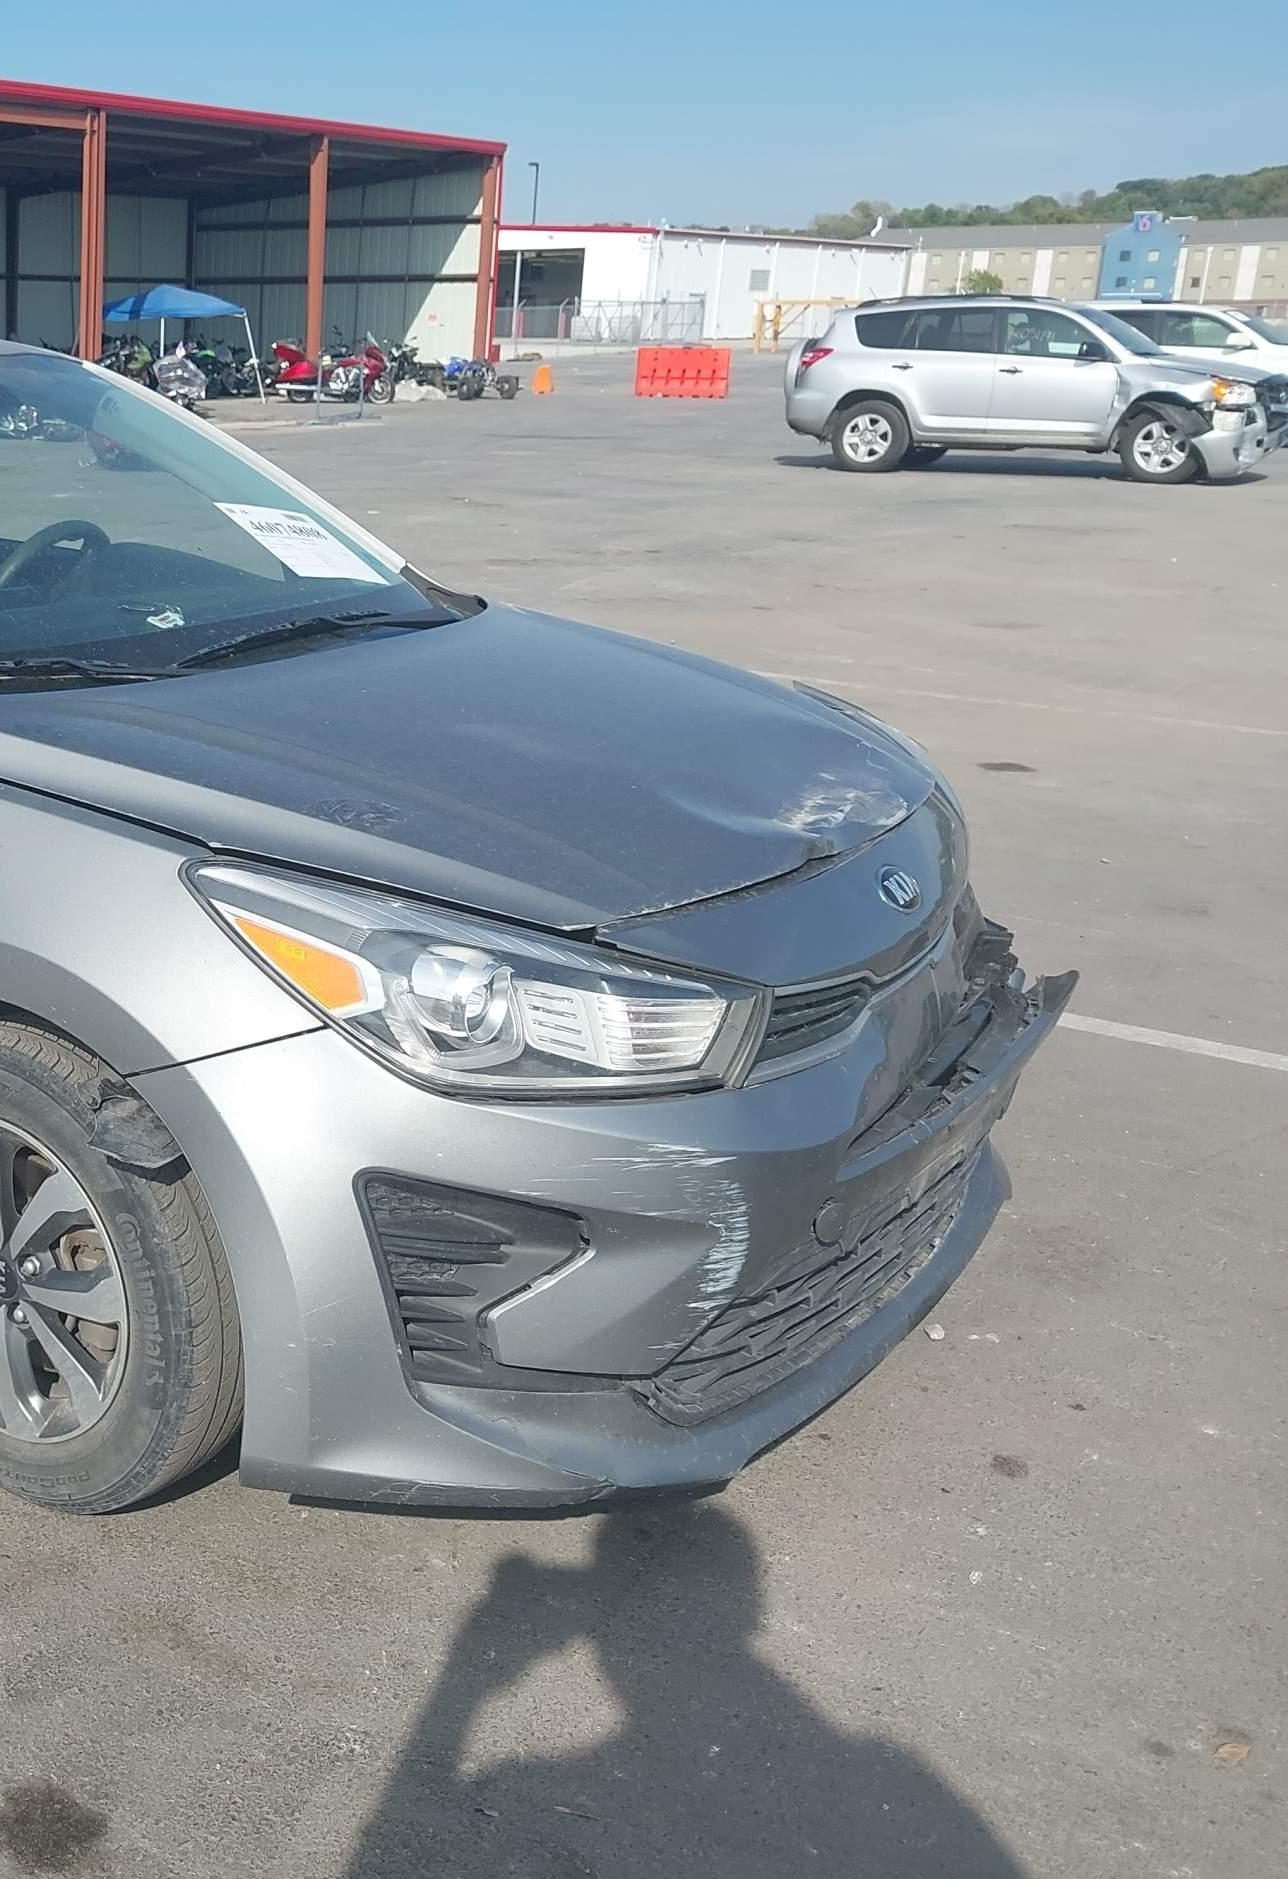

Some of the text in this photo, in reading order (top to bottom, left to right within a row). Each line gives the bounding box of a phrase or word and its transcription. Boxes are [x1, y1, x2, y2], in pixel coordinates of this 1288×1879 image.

[249, 520, 328, 540] 46074808
[883, 872, 920, 905] KIA
[114, 1212, 166, 1368] Continental
